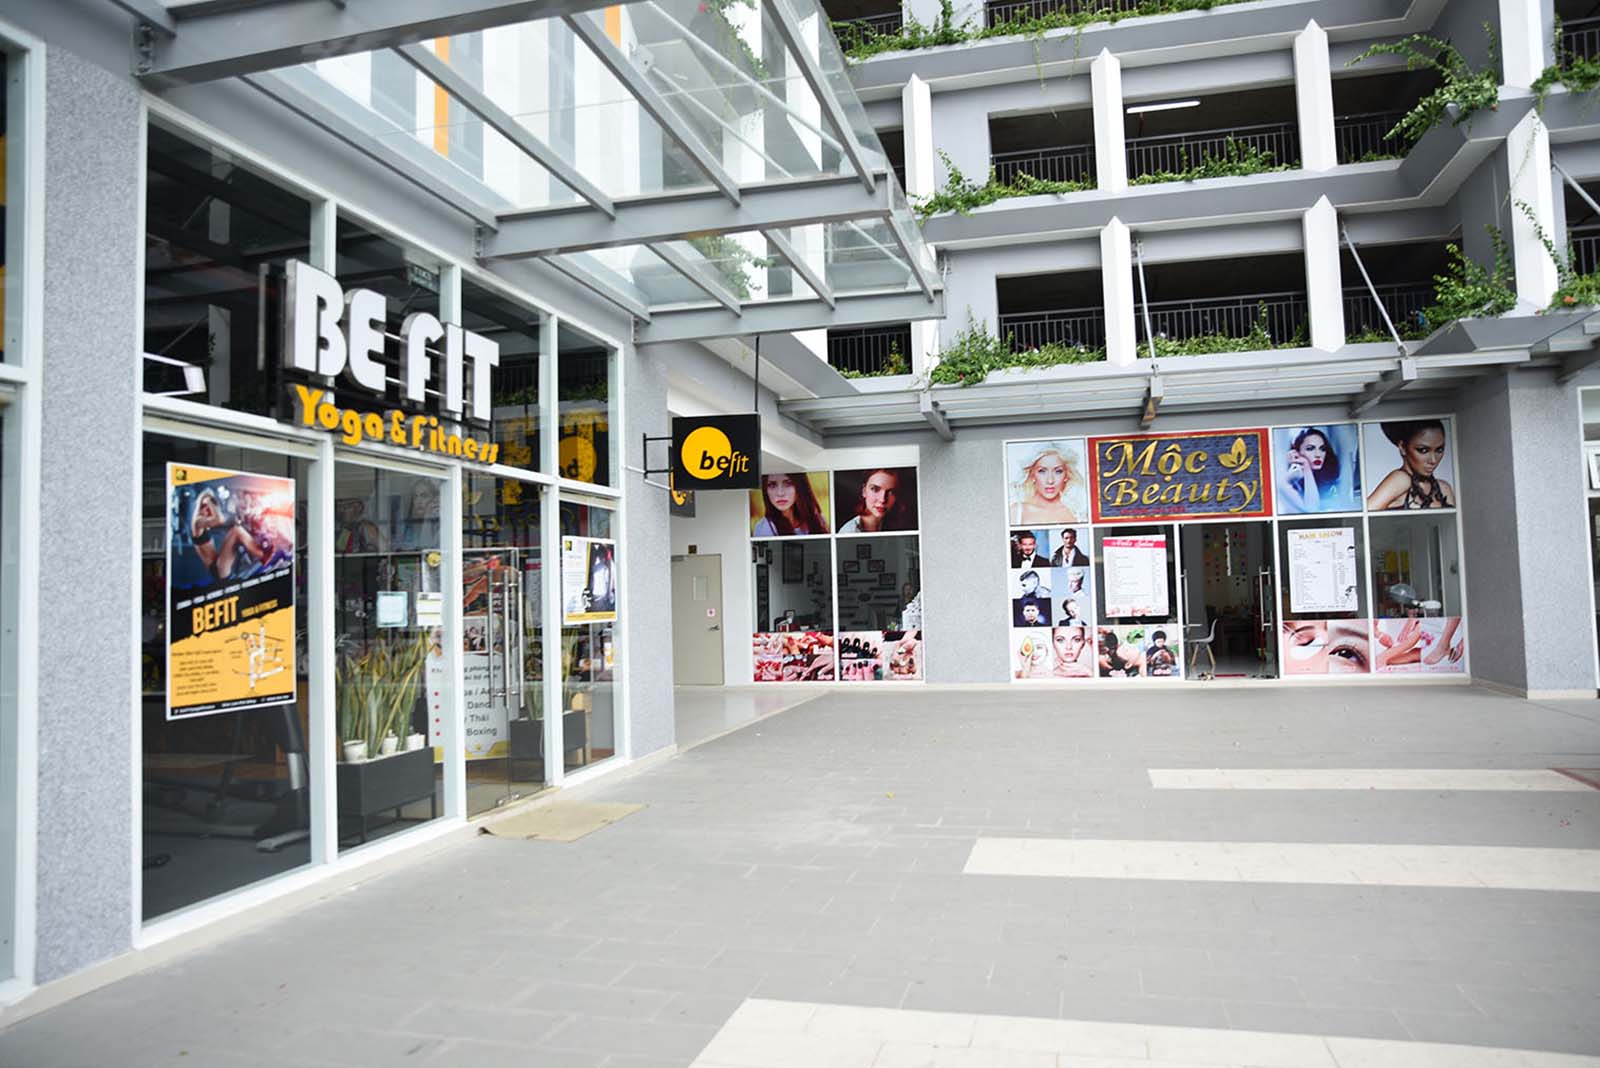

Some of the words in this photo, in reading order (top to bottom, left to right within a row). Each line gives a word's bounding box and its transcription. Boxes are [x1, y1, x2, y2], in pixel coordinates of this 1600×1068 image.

[287, 258, 387, 392] BE
[295, 384, 384, 446] Yoga
[390, 409, 407, 445] &
[412, 415, 499, 464] Fitness
[699, 450, 750, 478] befit
[1103, 440, 1208, 482] Mộc
[1103, 477, 1258, 513] Beauty
[191, 596, 240, 634] BEFIT
[466, 727, 497, 736] Boxing
